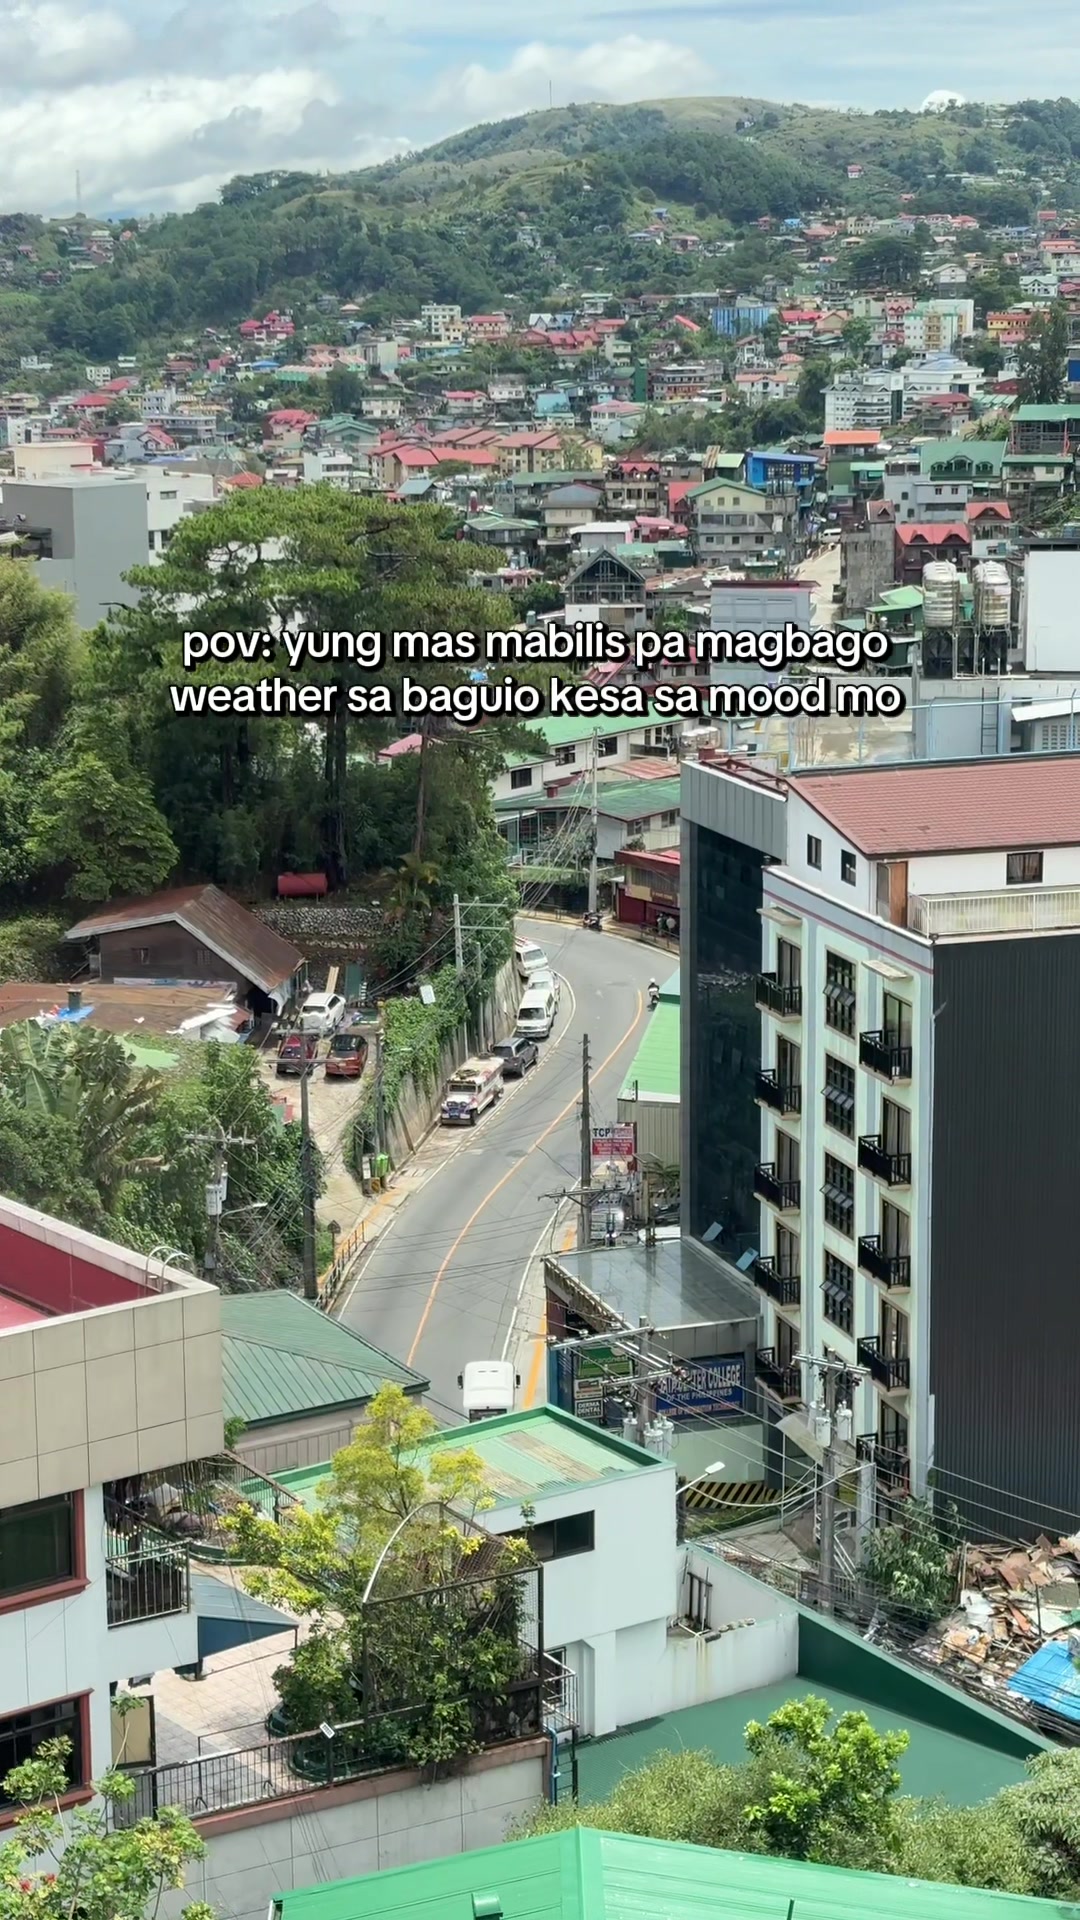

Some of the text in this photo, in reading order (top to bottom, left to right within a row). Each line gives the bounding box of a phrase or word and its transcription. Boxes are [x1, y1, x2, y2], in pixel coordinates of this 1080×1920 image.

[593, 1127, 611, 1138] TCP
[707, 1364, 740, 1390] COLLEGE
[677, 1392, 690, 1401] THE
[578, 1401, 600, 1409] DERMA
[577, 1407, 600, 1415] DENTAL
